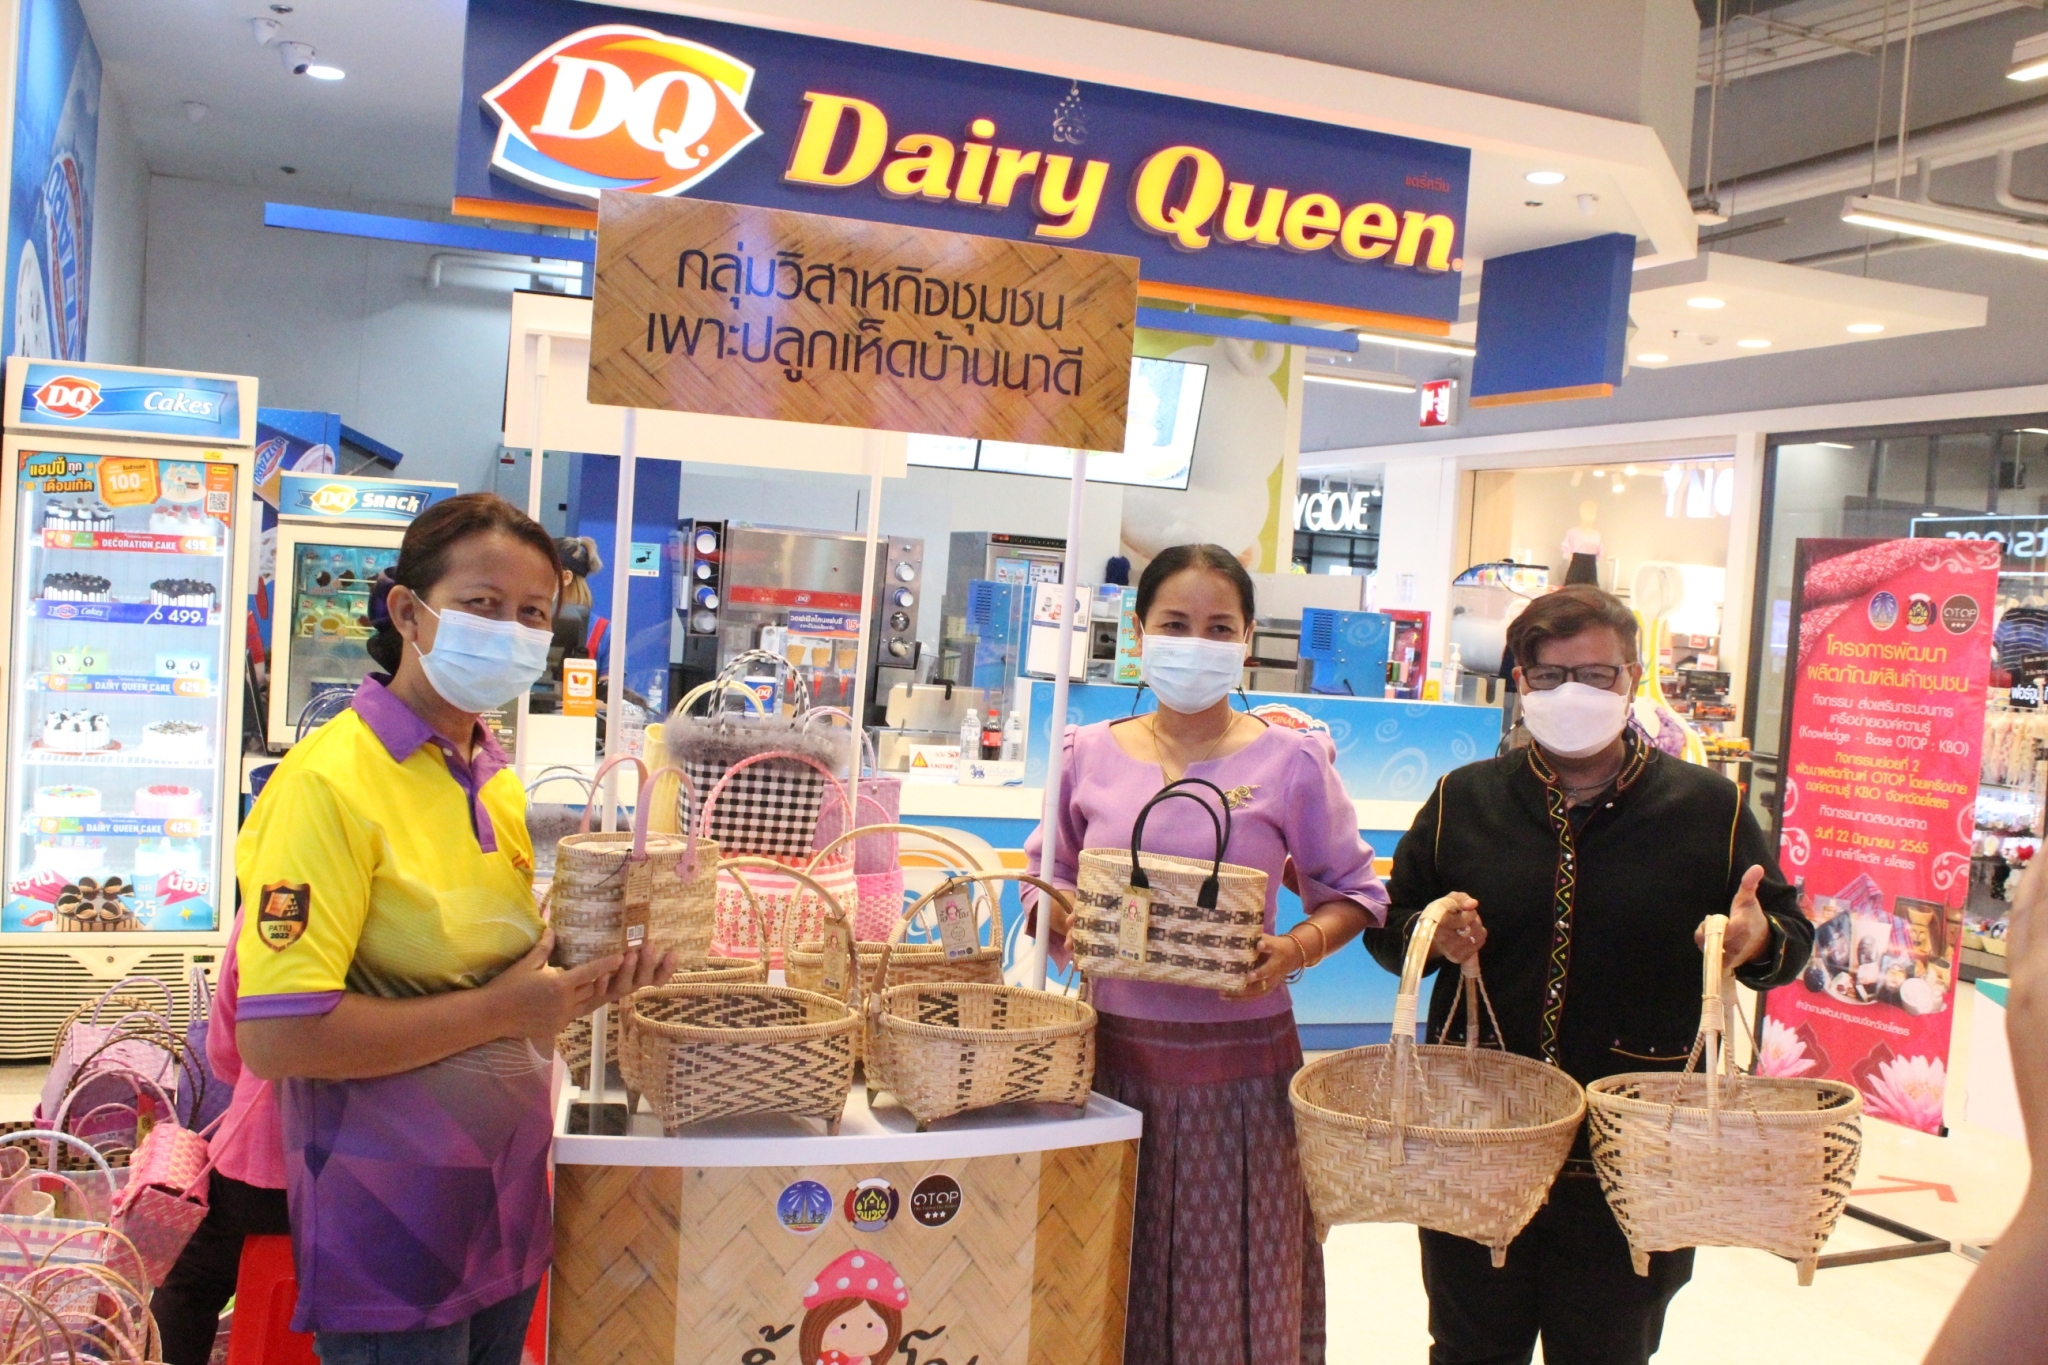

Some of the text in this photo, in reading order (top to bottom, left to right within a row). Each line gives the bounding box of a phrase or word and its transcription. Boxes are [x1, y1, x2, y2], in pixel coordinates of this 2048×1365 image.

[530, 55, 717, 170] DQ
[785, 91, 1458, 272] Dairy Queen
[677, 241, 1065, 335] กลุ่มวิสาหกิจชุมชน
[646, 312, 1084, 397] เพาะปลูกเห็ดบ้านนาดี
[46, 385, 213, 416] DQ Cakes
[29, 456, 67, 477] แฮปปี้
[361, 492, 419, 513] Snack
[102, 538, 176, 550] DECORATION CAKE
[1943, 607, 1977, 617] OTOP
[1826, 634, 1947, 662] โครงการพัฒนา
[94, 681, 170, 692] DAIRY QUEEN CAKE
[1807, 663, 1969, 695] ผลิตภัณฑ์สินค้าชุมชน
[1865, 732, 1892, 747] Base
[1896, 735, 1928, 750] OTOP
[1912, 760, 1920, 772] 2
[1871, 771, 1906, 785] OTOP
[1854, 787, 1880, 799] KBO
[86, 824, 161, 833] DAIRY QUEEN CAKE
[1836, 829, 1849, 842] 22
[1900, 839, 1928, 854] 2565
[913, 1191, 959, 1206] OTOP
